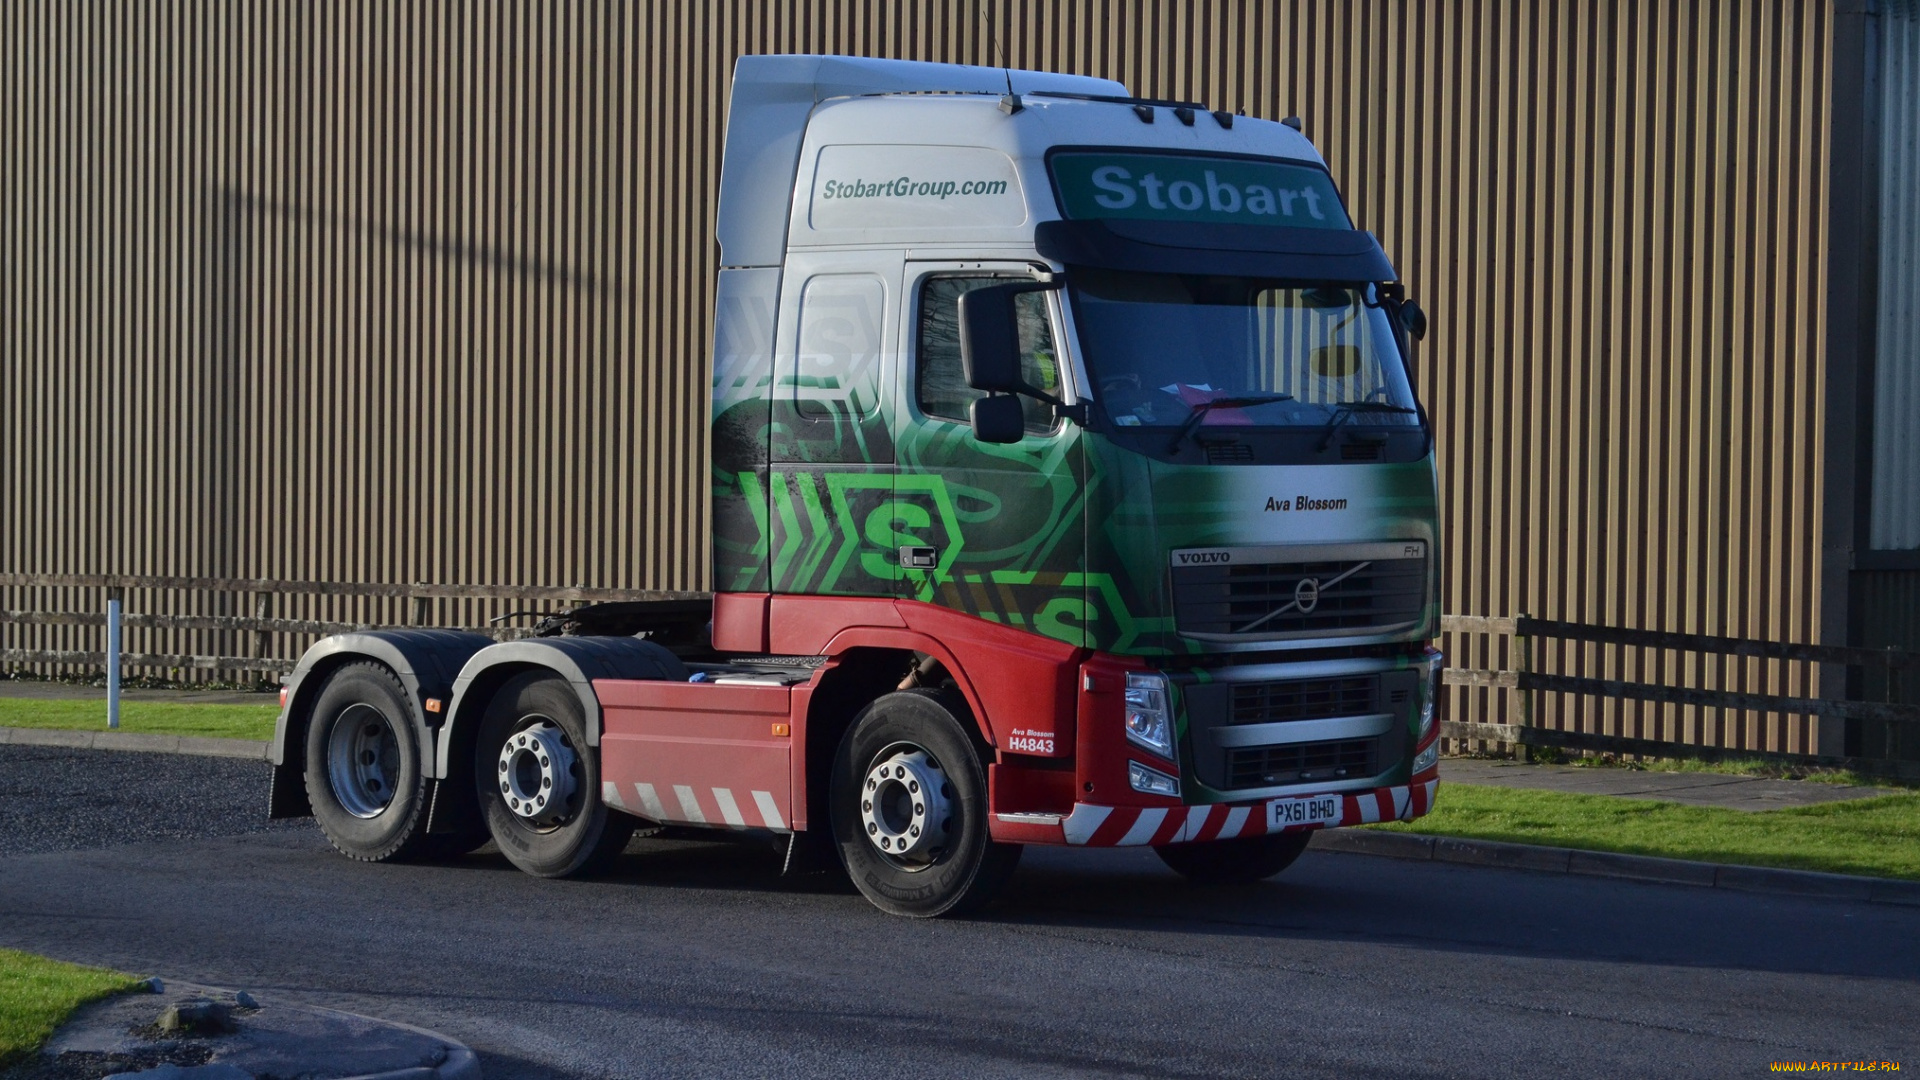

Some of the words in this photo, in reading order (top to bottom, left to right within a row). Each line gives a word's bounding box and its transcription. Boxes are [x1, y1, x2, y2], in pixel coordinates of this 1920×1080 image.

[823, 176, 1008, 200] StobartGroup.com
[1093, 165, 1327, 222] Stobart
[1264, 497, 1291, 512] Ava
[1296, 495, 1348, 511] Blossom
[1178, 552, 1231, 564] VOLVO
[1403, 545, 1420, 557] FH
[1011, 728, 1025, 736] Ava
[1026, 729, 1055, 738] Blossom
[1009, 736, 1054, 753] H4843
[1275, 802, 1306, 824] PX61
[1309, 799, 1335, 820] BHD
